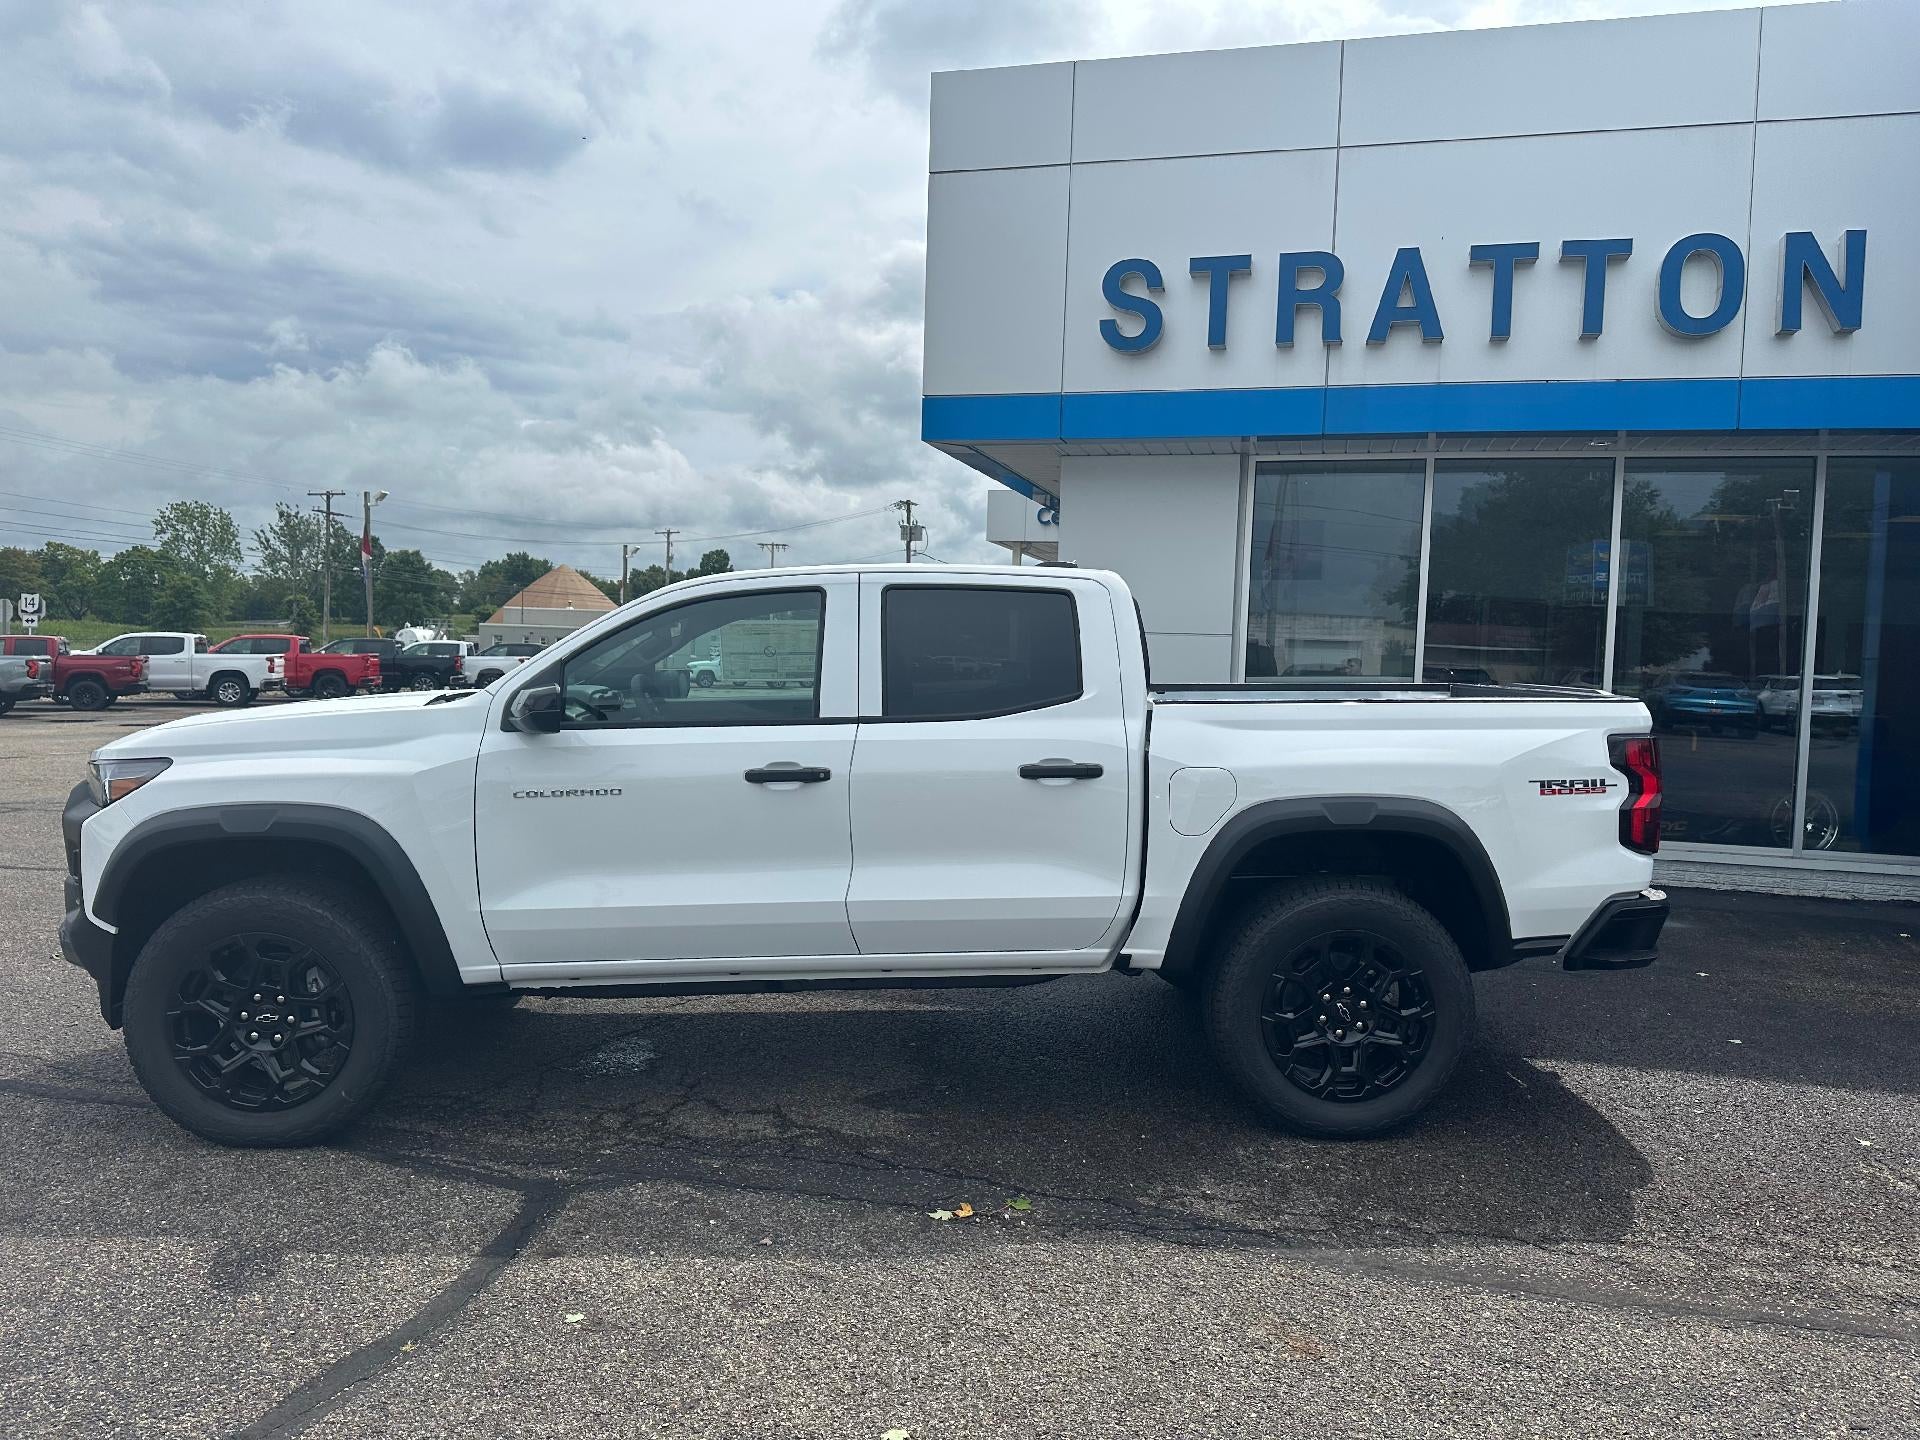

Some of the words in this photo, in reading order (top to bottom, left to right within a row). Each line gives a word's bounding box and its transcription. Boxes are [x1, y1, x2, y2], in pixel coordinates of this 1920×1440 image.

[1098, 229, 1868, 354] STRATTON
[24, 597, 36, 608] 14
[1528, 779, 1618, 788] TRAIL
[512, 788, 622, 799] COLORADO
[1539, 787, 1607, 796] BOSS
